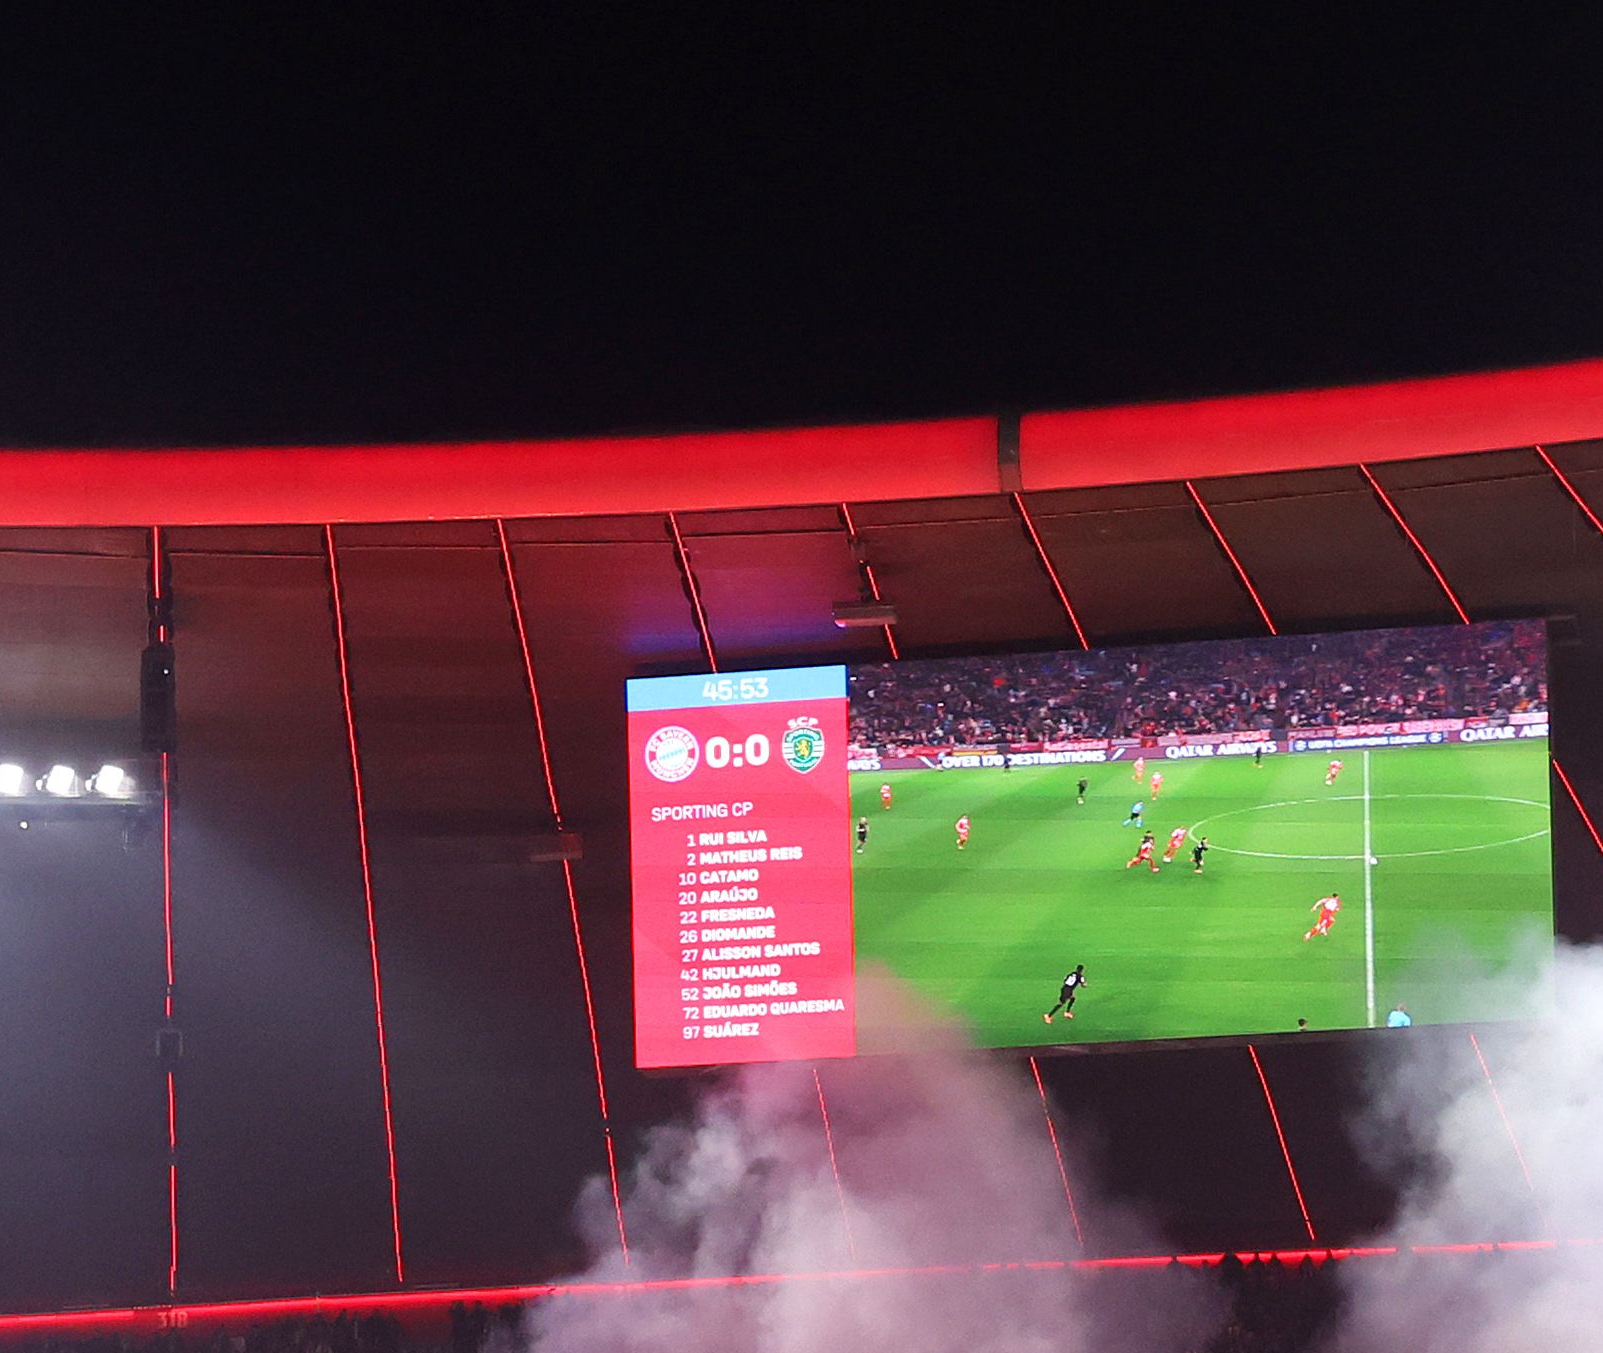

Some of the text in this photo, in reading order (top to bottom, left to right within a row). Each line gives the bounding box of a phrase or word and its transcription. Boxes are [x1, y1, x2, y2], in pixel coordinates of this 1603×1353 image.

[702, 677, 769, 701] 45:53
[787, 716, 819, 729] SCP
[1461, 726, 1515, 742] QATAR
[705, 734, 770, 768] 0:0
[1166, 740, 1276, 759] QATAR AIRWAYS
[942, 750, 1106, 769] OVER 170 DESTINATIONS
[651, 802, 753, 822] SPORTING CP
[687, 830, 767, 847] 1 RUI SILVA
[687, 846, 803, 866] 2 MATHEUS REIS
[679, 869, 759, 886] 10 CATAMO
[679, 886, 758, 905] 20 ARAÚJO
[680, 906, 775, 924] 22 FRESNEDA
[680, 925, 776, 943] 26 DIOMANDE
[682, 942, 820, 962] 27 ALISSON SANTOS
[680, 963, 781, 981] 42 HJULMAND
[681, 980, 797, 1001] 52 JOÃO SIMÕES
[682, 999, 845, 1020] 72 EDUARDO QUARESMA
[683, 1021, 759, 1039] 97 SUÁREZ
[157, 1311, 189, 1328] 318
